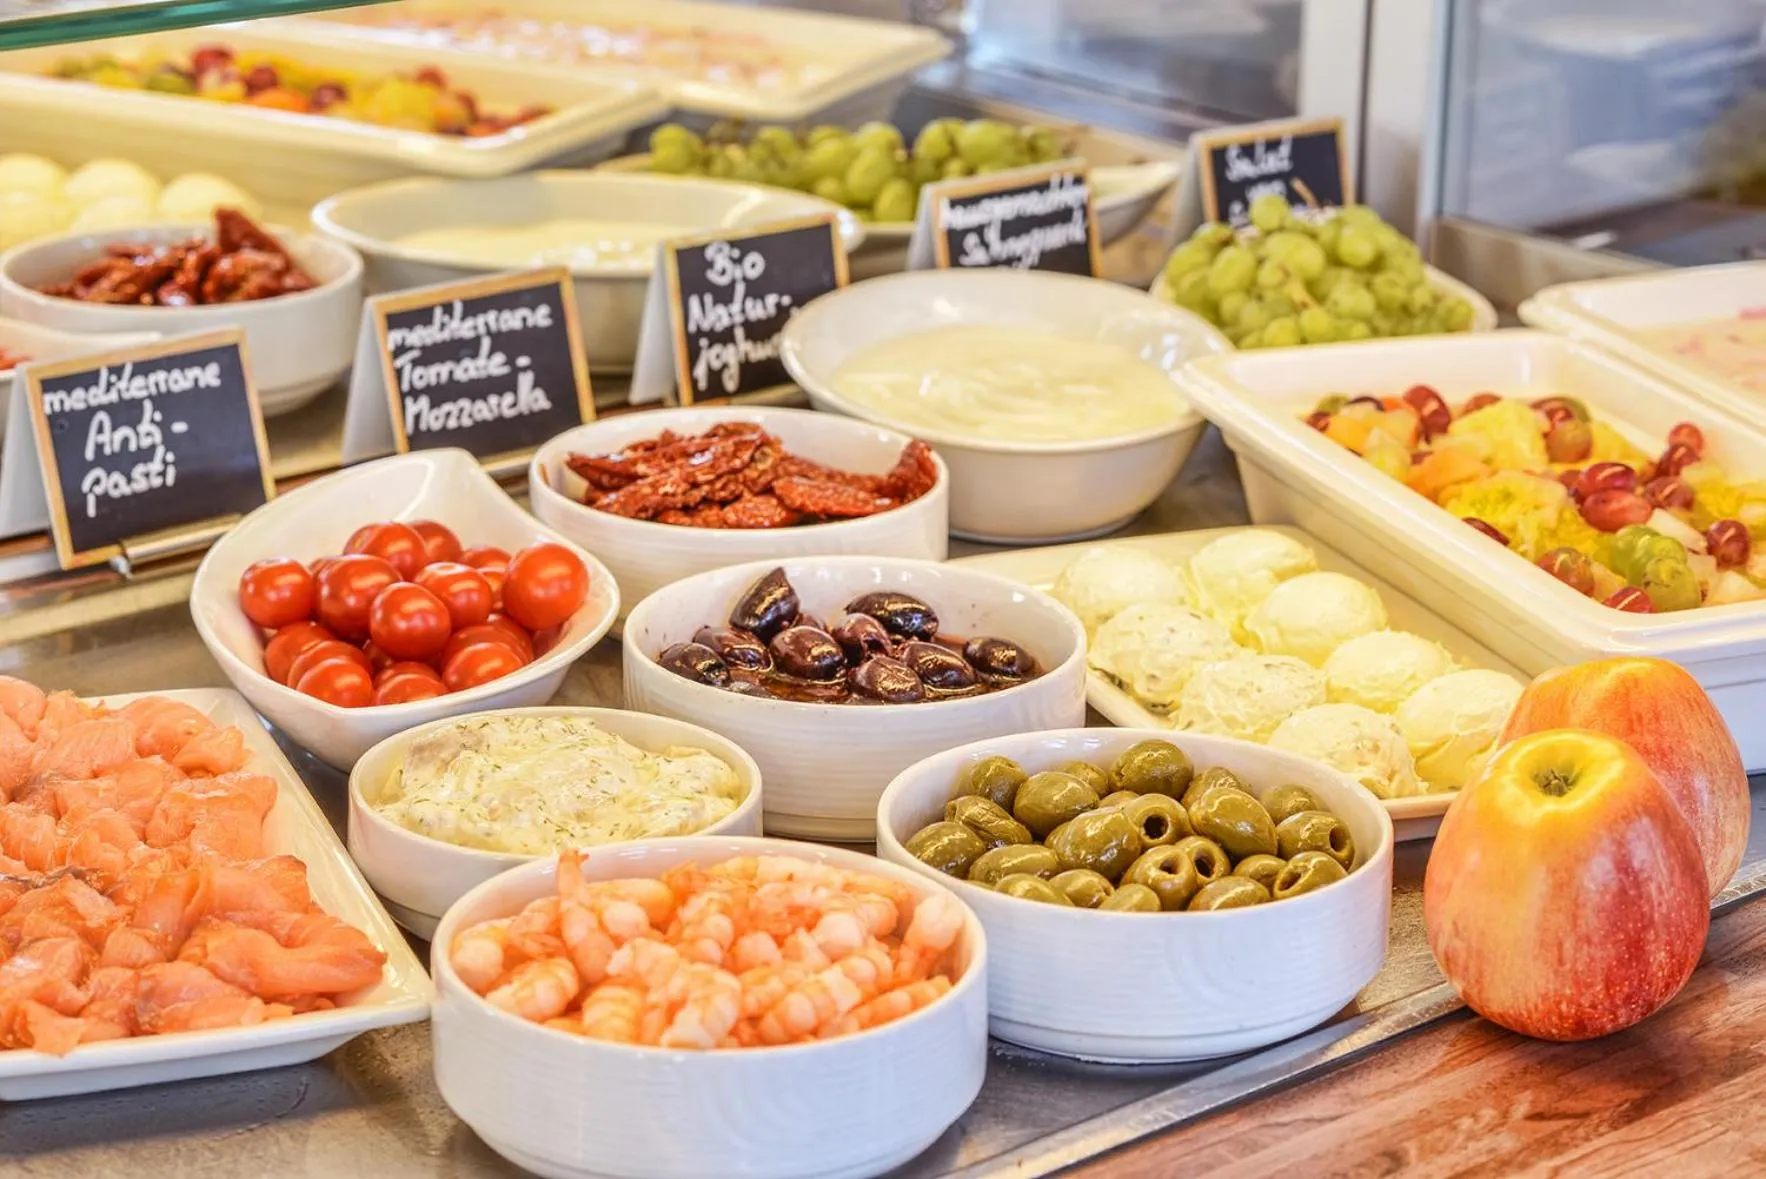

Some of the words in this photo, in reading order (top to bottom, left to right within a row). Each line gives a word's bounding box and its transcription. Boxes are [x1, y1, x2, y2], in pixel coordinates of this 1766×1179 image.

[704, 240, 766, 286] Bio
[387, 300, 552, 351] mediterrane
[43, 362, 221, 415] mediterrane
[404, 370, 552, 436] Mozzarella
[81, 444, 177, 518] pasti
